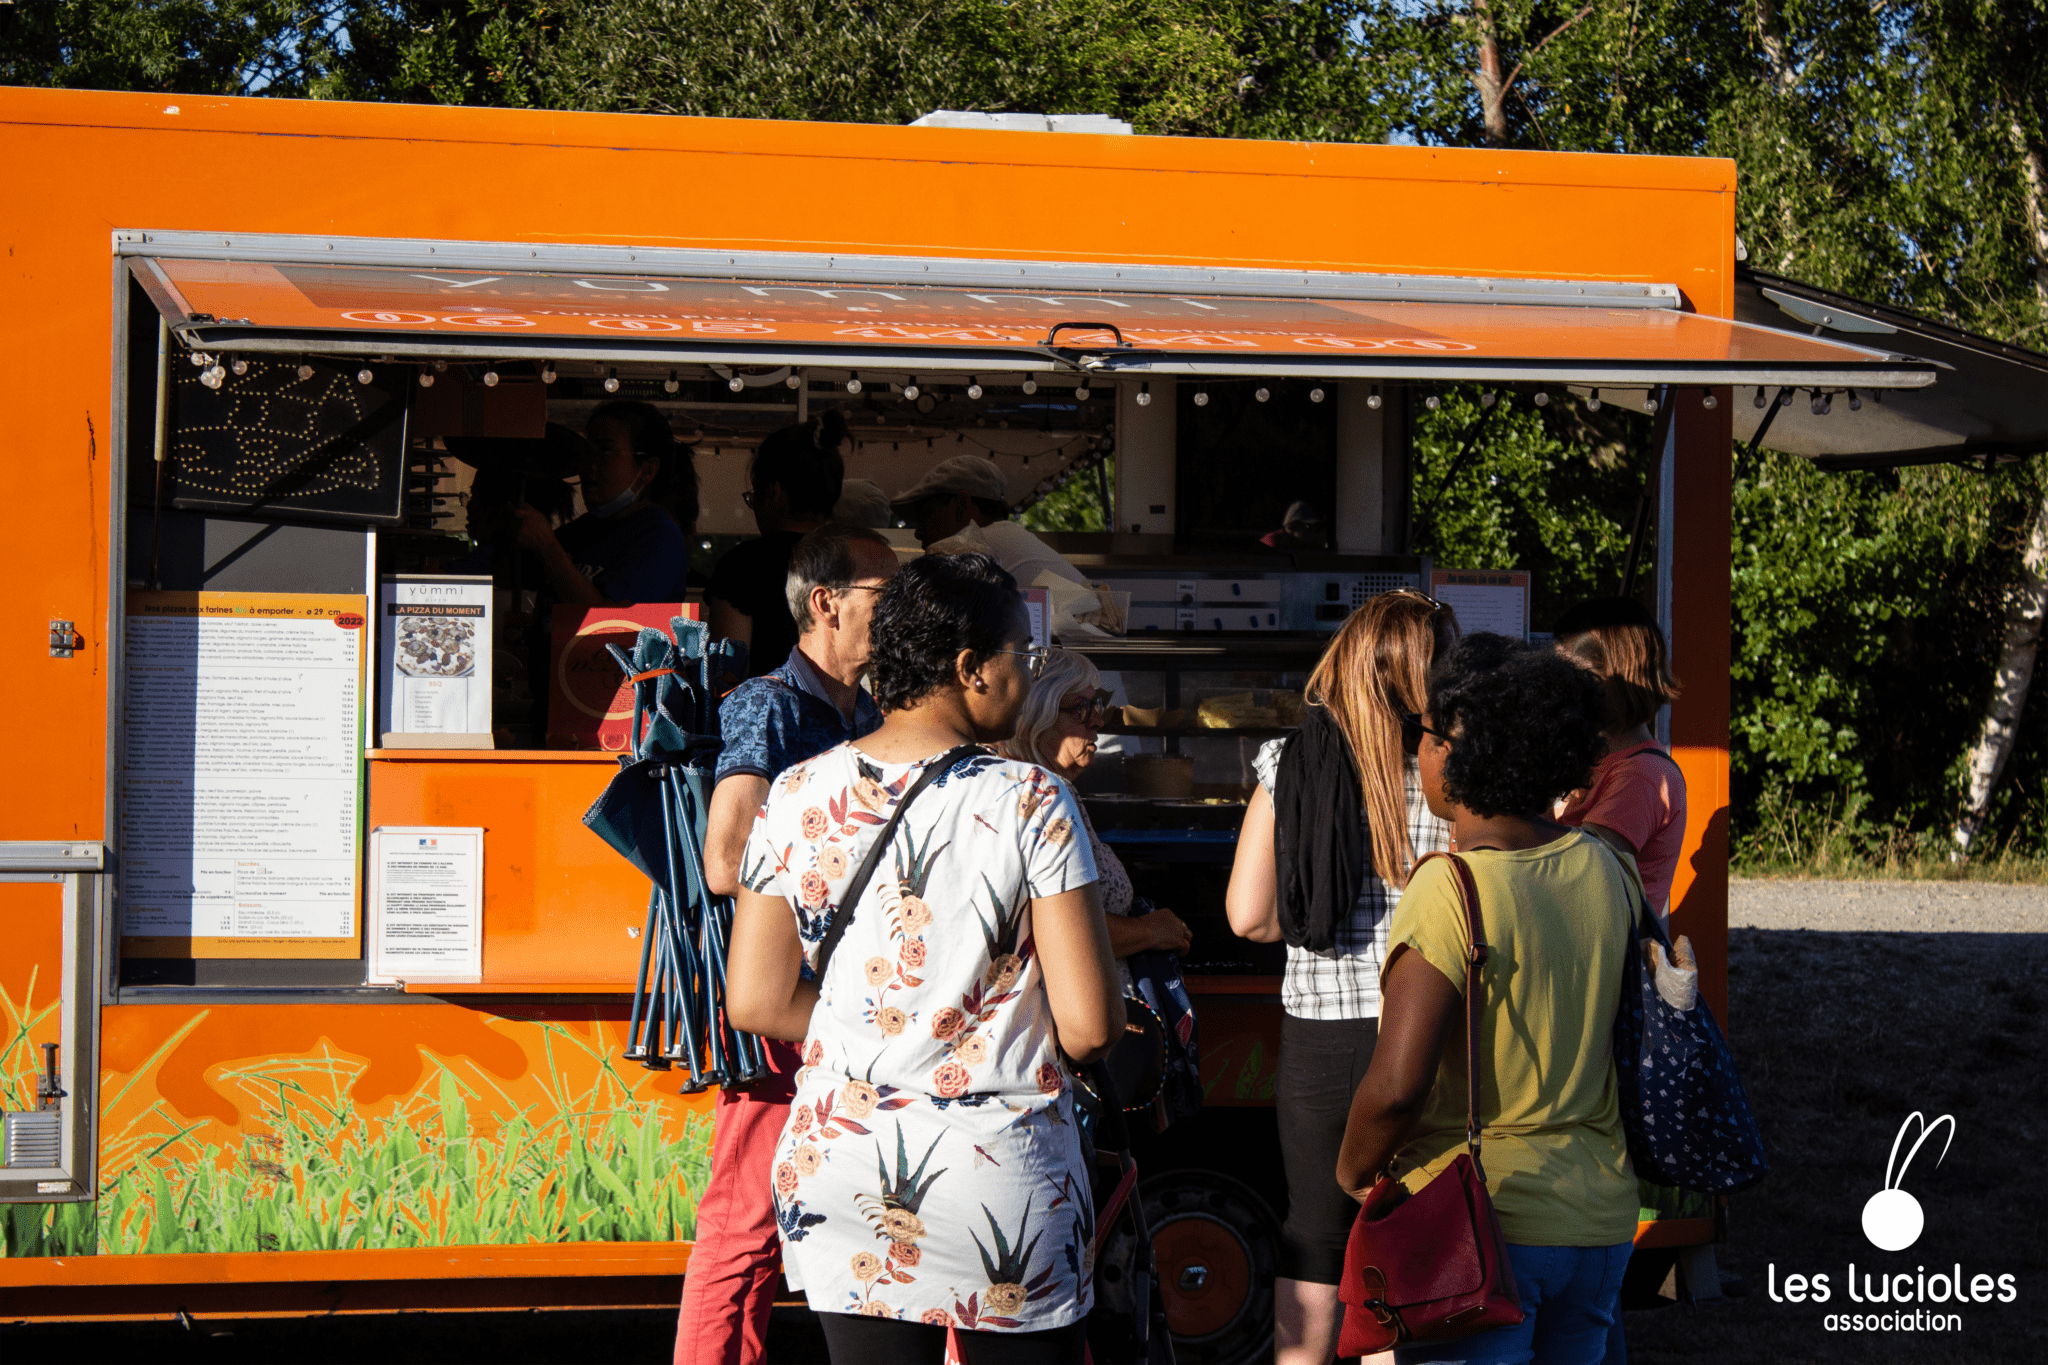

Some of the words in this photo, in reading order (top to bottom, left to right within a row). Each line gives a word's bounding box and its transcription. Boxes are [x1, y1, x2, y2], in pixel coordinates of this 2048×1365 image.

[341, 311, 536, 327] 06
[588, 319, 777, 334] 05
[832, 327, 1026, 341] 44
[1070, 332, 1260, 346] 44
[1293, 338, 1477, 351] 00
[162, 605, 186, 613] pizzas
[257, 608, 294, 616] emporter
[339, 617, 363, 625] 2022
